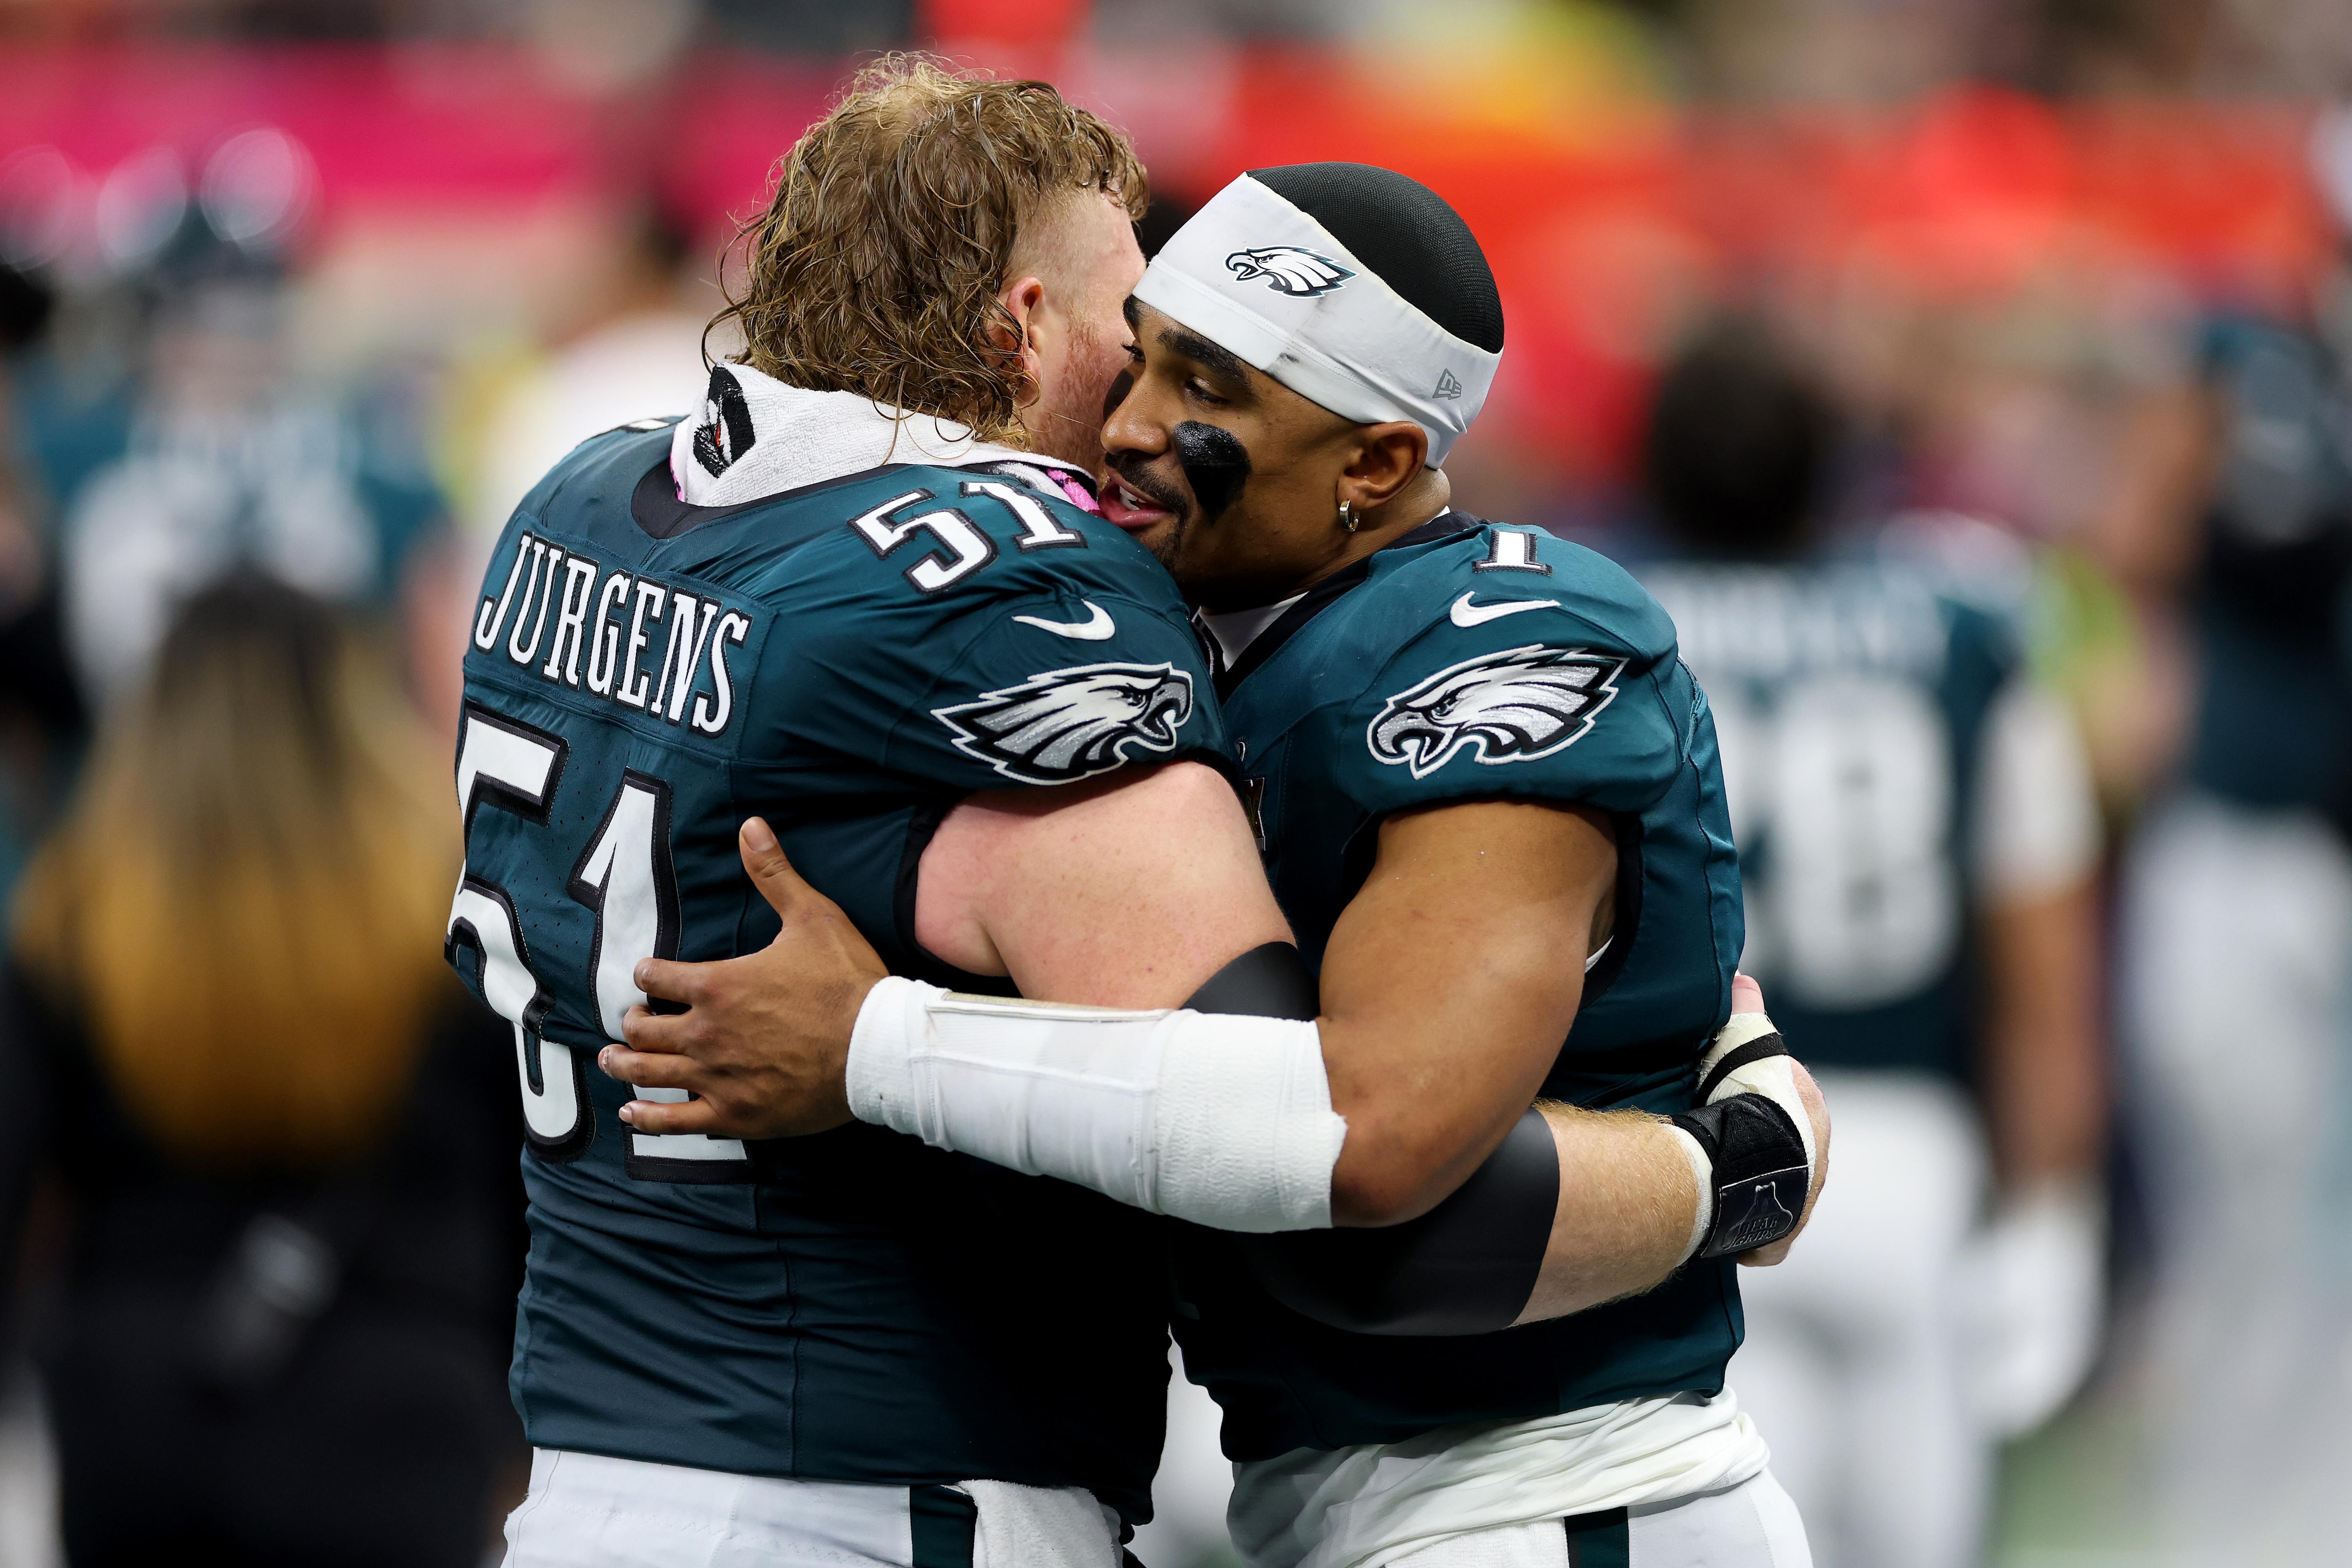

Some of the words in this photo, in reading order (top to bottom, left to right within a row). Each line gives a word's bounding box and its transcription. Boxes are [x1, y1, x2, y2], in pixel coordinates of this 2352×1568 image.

[847, 480, 1088, 594] 51
[1472, 529, 1553, 577] 1
[471, 530, 754, 737] JURGENS
[445, 701, 754, 1183] 51
[1732, 1227, 1776, 1247] GRIPS
